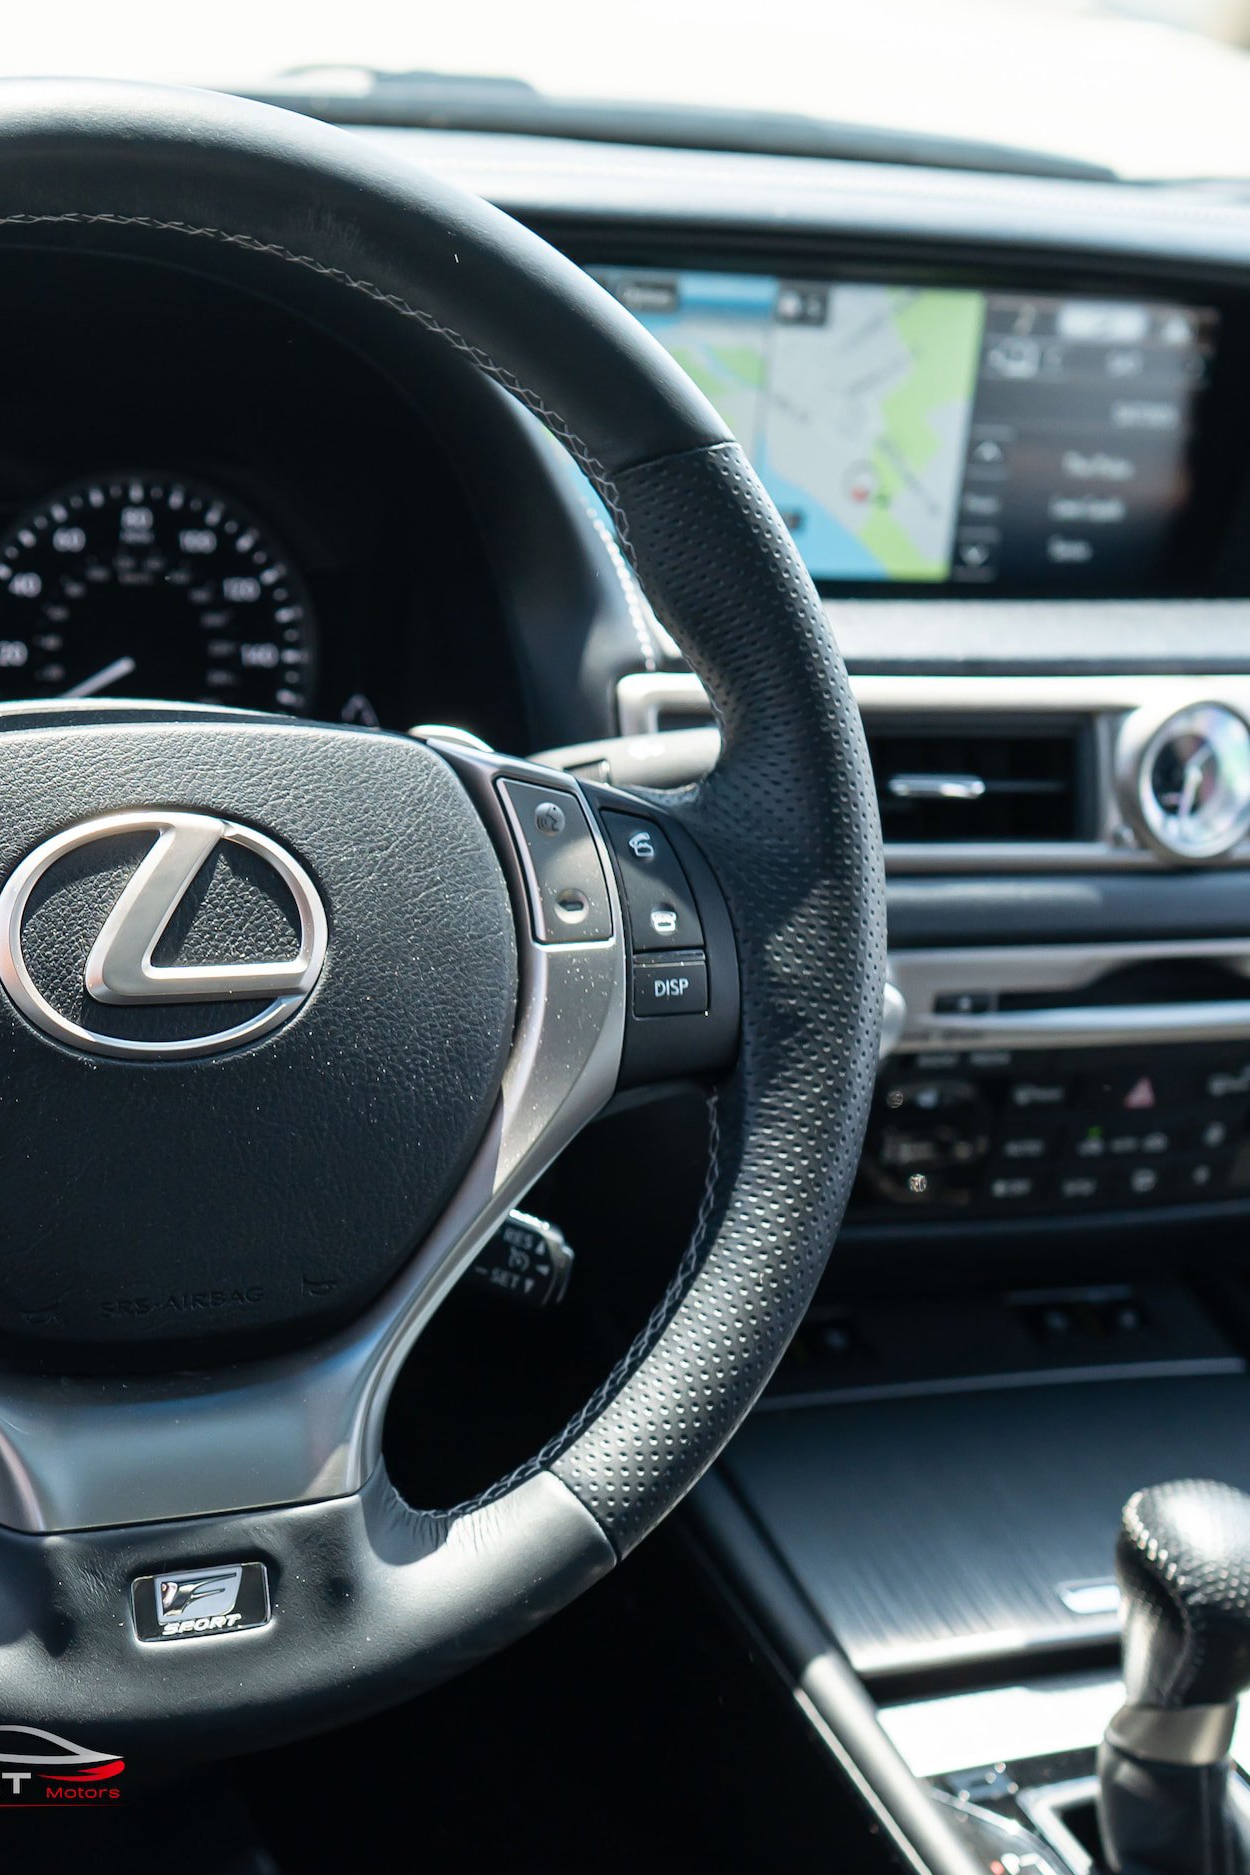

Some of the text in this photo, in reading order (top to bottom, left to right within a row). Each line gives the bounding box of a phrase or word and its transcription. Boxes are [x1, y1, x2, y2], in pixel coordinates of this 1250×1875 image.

[654, 978, 689, 997] DISP
[99, 1285, 265, 1318] SRS AIRBAG
[161, 1613, 242, 1636] SPORT
